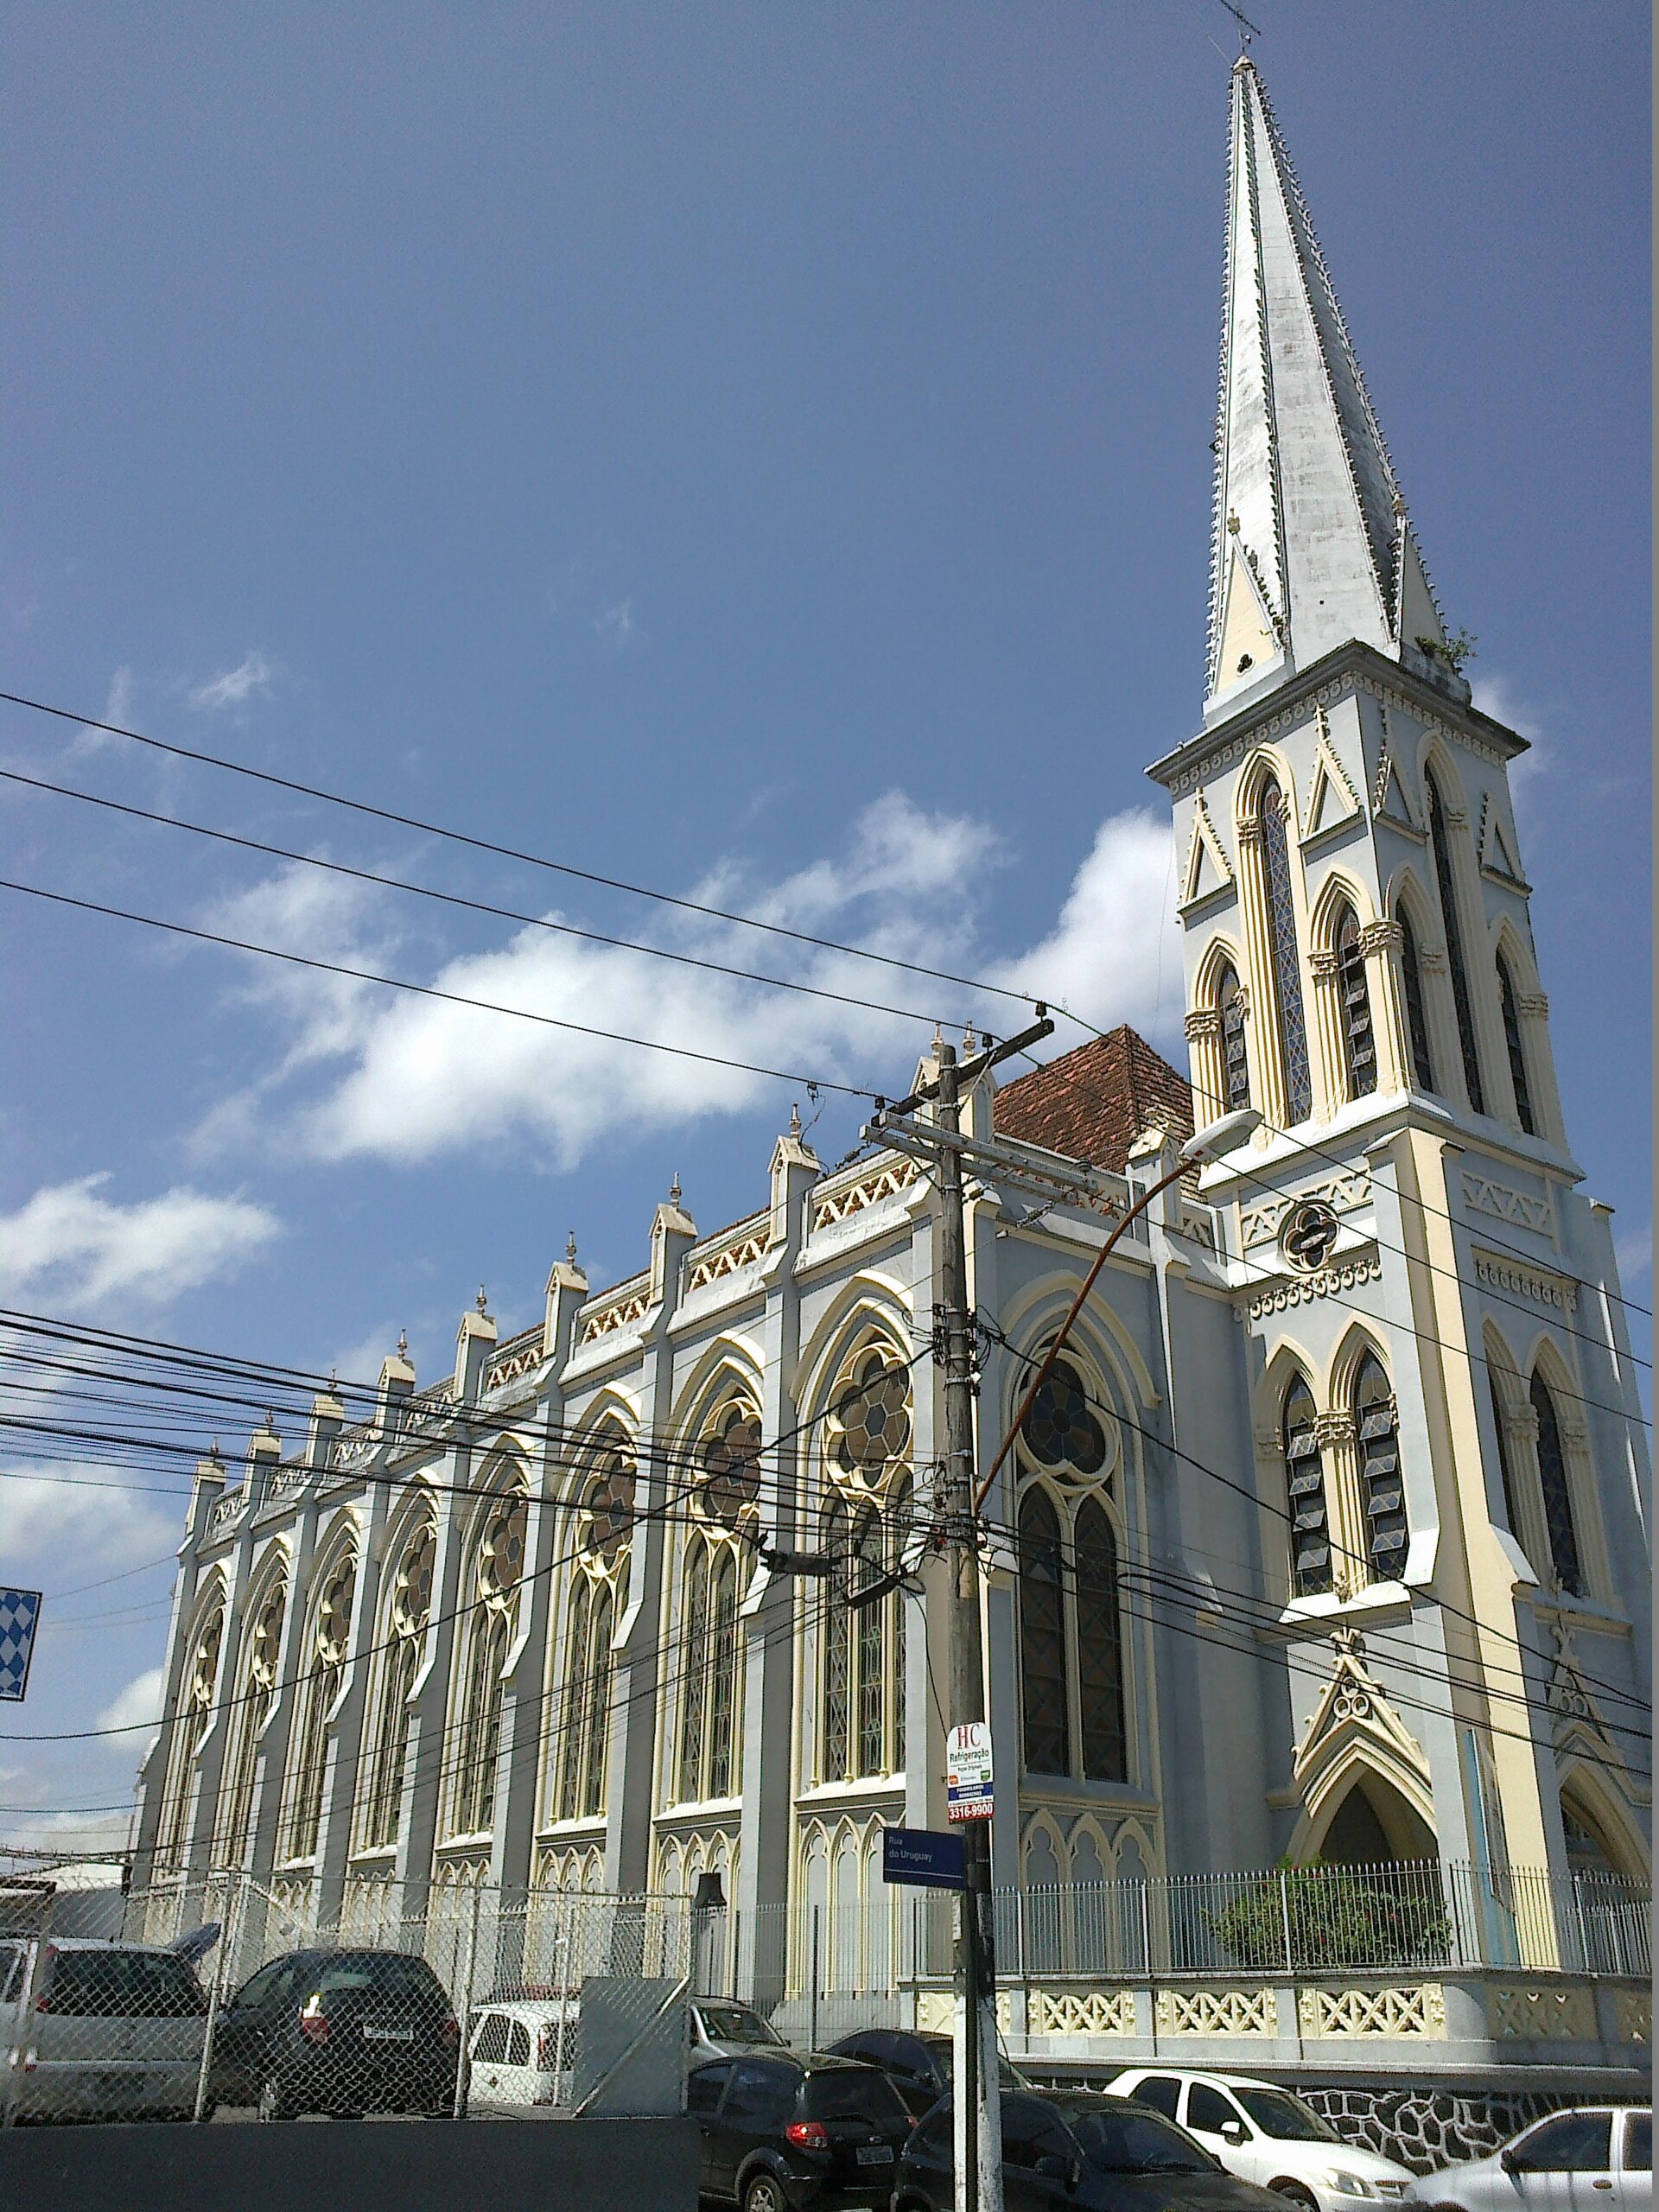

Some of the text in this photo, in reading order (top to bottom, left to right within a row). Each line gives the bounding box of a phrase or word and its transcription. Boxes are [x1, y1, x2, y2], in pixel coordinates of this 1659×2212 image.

[957, 1724, 980, 1749] HC
[950, 1748, 989, 1763] Refrigeração
[949, 1803, 993, 1819] 3316-9900
[888, 1836, 903, 1846] Rua
[889, 1849, 932, 1863] do Uruguay
